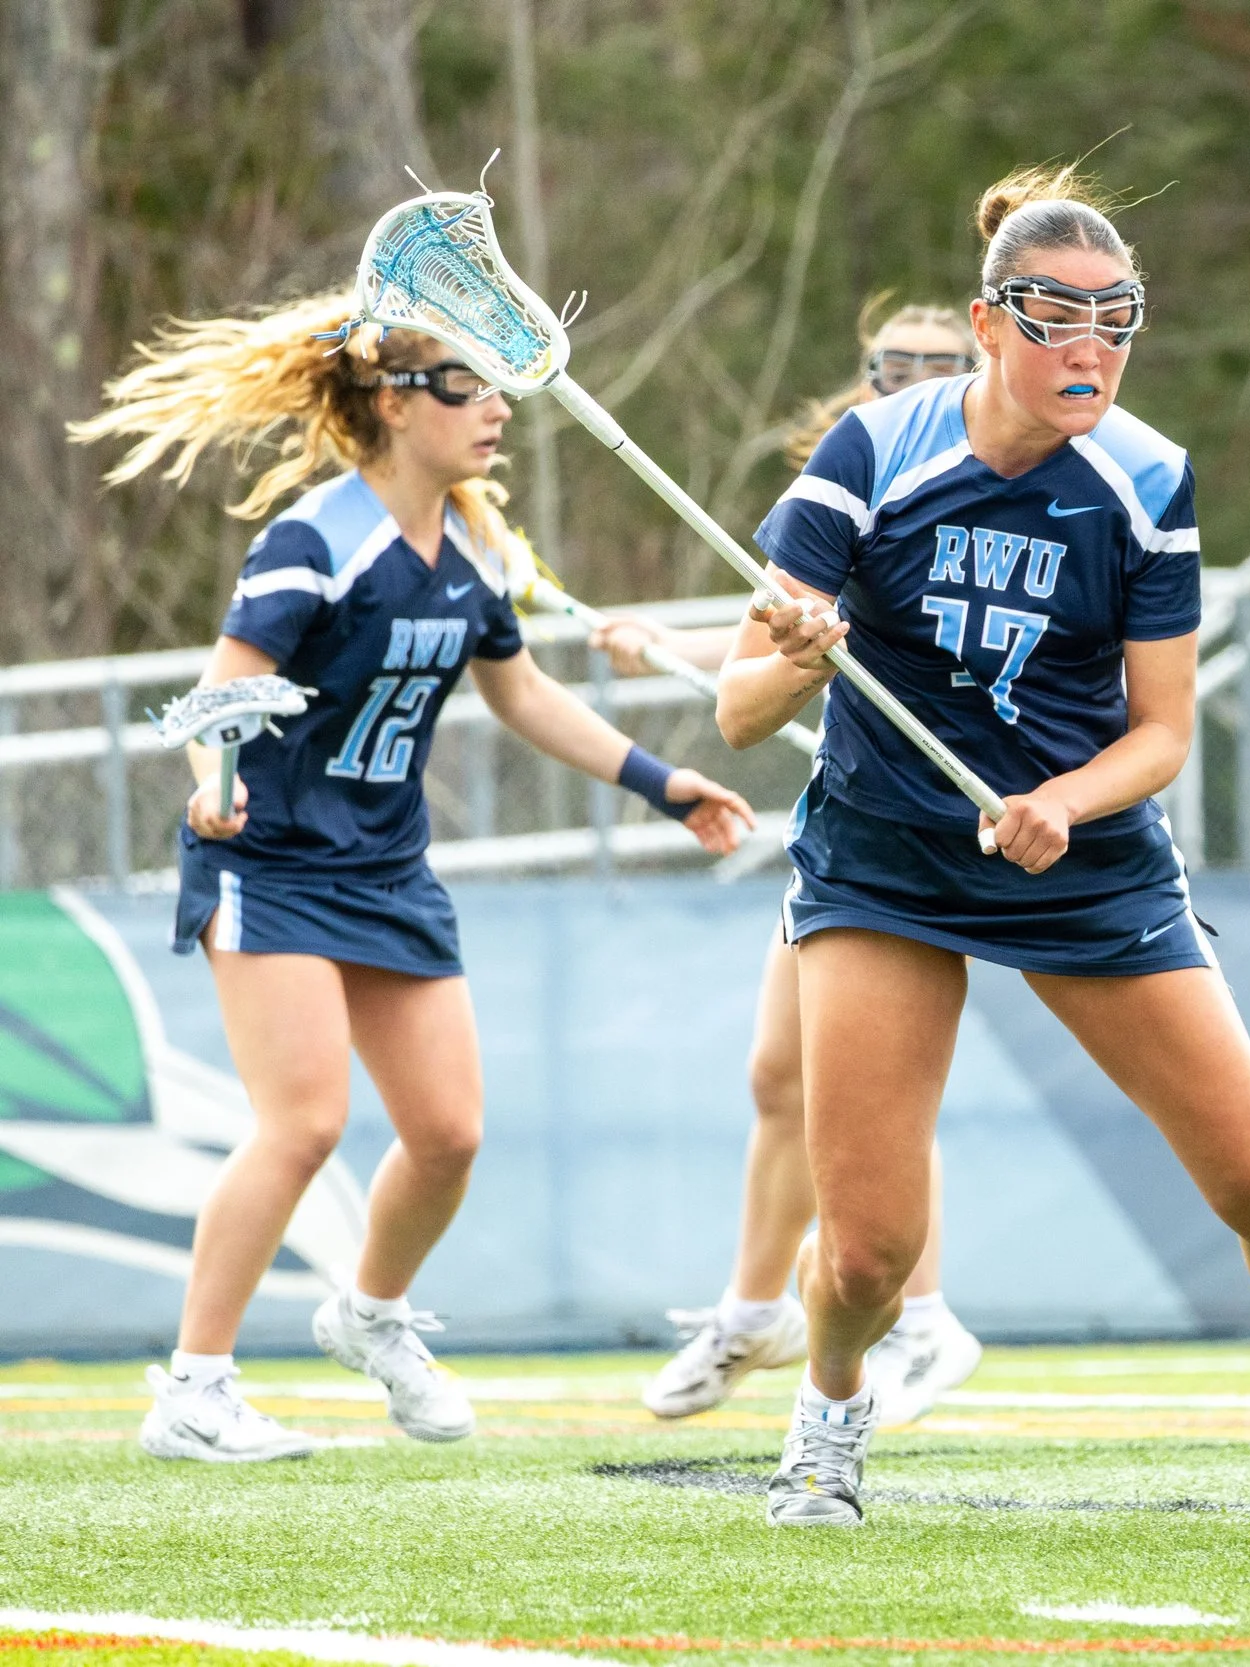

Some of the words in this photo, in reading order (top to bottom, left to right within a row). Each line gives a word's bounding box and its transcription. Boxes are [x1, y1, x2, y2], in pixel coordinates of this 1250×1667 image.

[928, 524, 1067, 599] RWU
[382, 617, 468, 669] RWU
[921, 594, 1051, 725] 17
[325, 675, 442, 783] 12
